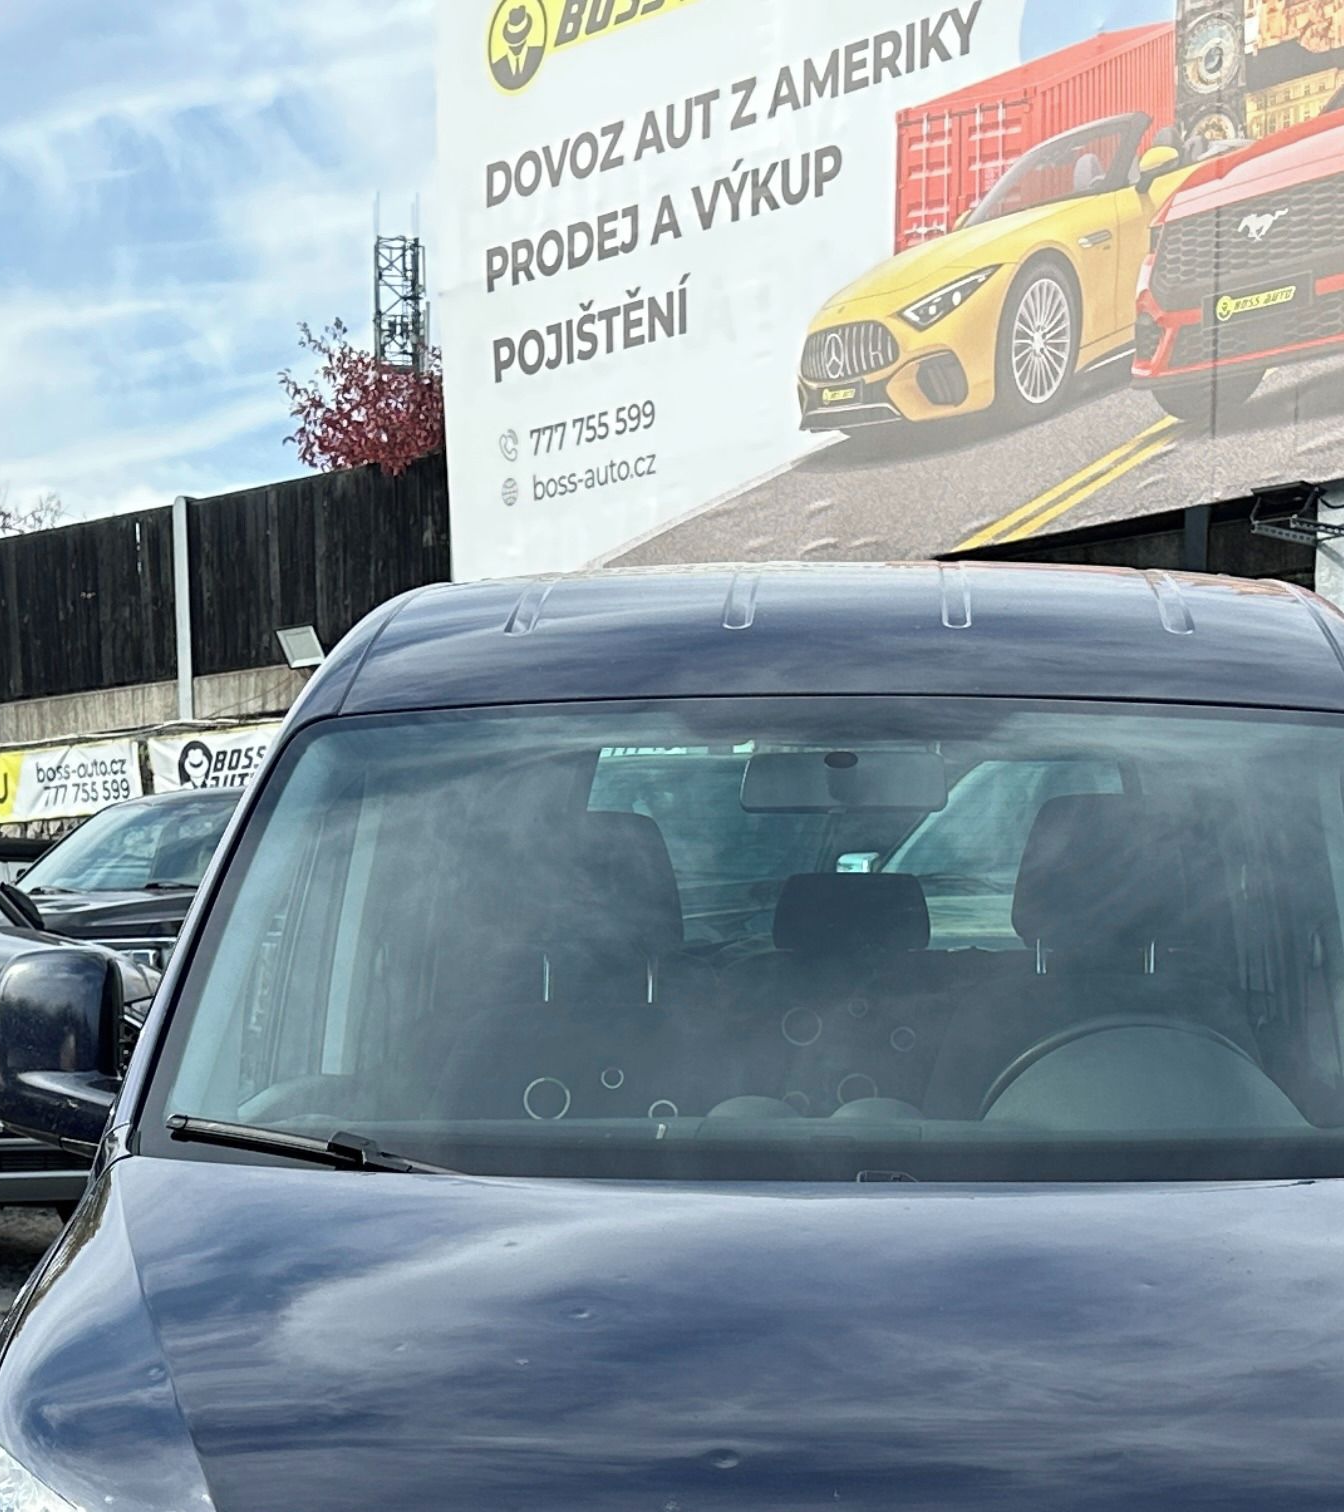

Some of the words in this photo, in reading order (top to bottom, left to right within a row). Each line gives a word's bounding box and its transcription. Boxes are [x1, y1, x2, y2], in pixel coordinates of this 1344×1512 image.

[485, 121, 625, 208] DOVOZ
[633, 90, 719, 163] AUT
[729, 81, 757, 130] Z
[768, 0, 983, 118] AMERIKY
[485, 210, 639, 293] PRODEJ
[650, 196, 681, 245] A
[692, 144, 843, 230] VÝKUP
[493, 273, 692, 382] POJIŠTĚNÍ
[530, 424, 567, 457] 777
[573, 412, 610, 446] 755
[615, 400, 656, 435] 599
[532, 453, 656, 501] boss-auto.cz
[36, 757, 127, 784] boss-auto.cz
[43, 786, 68, 807] 777
[72, 782, 100, 803] 755
[102, 778, 130, 800] 599
